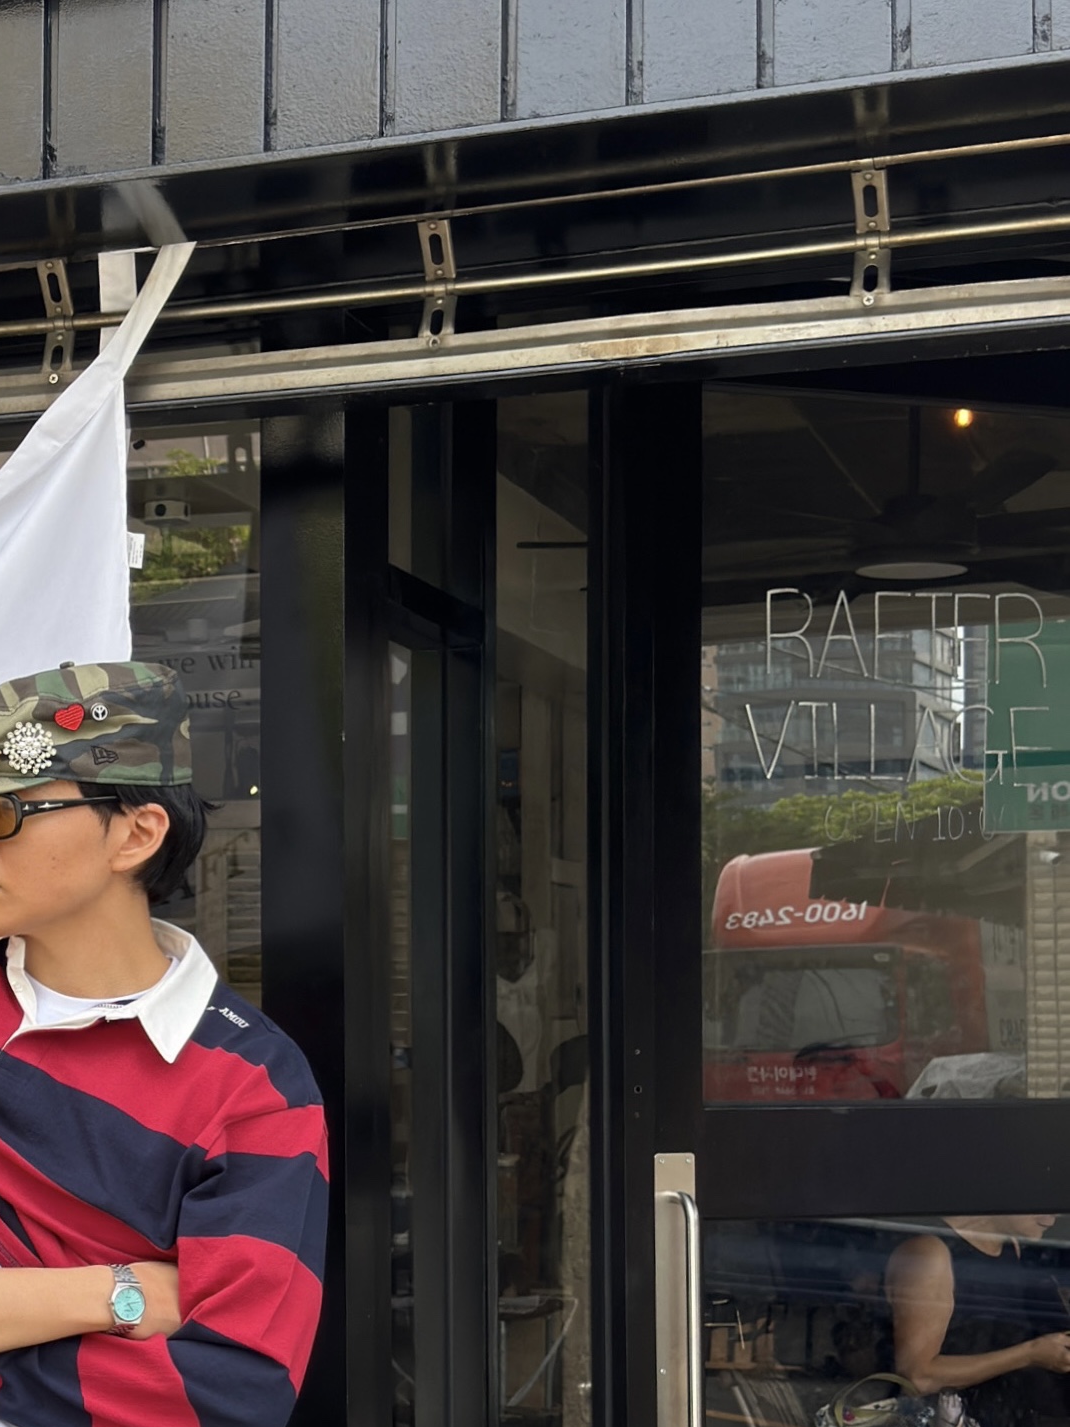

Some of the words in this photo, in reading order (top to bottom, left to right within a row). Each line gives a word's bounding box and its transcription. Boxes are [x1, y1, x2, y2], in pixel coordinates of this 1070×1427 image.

[766, 588, 1047, 688] RAFTER
[745, 700, 1052, 787] VILLAGE
[824, 800, 916, 843] OPEN
